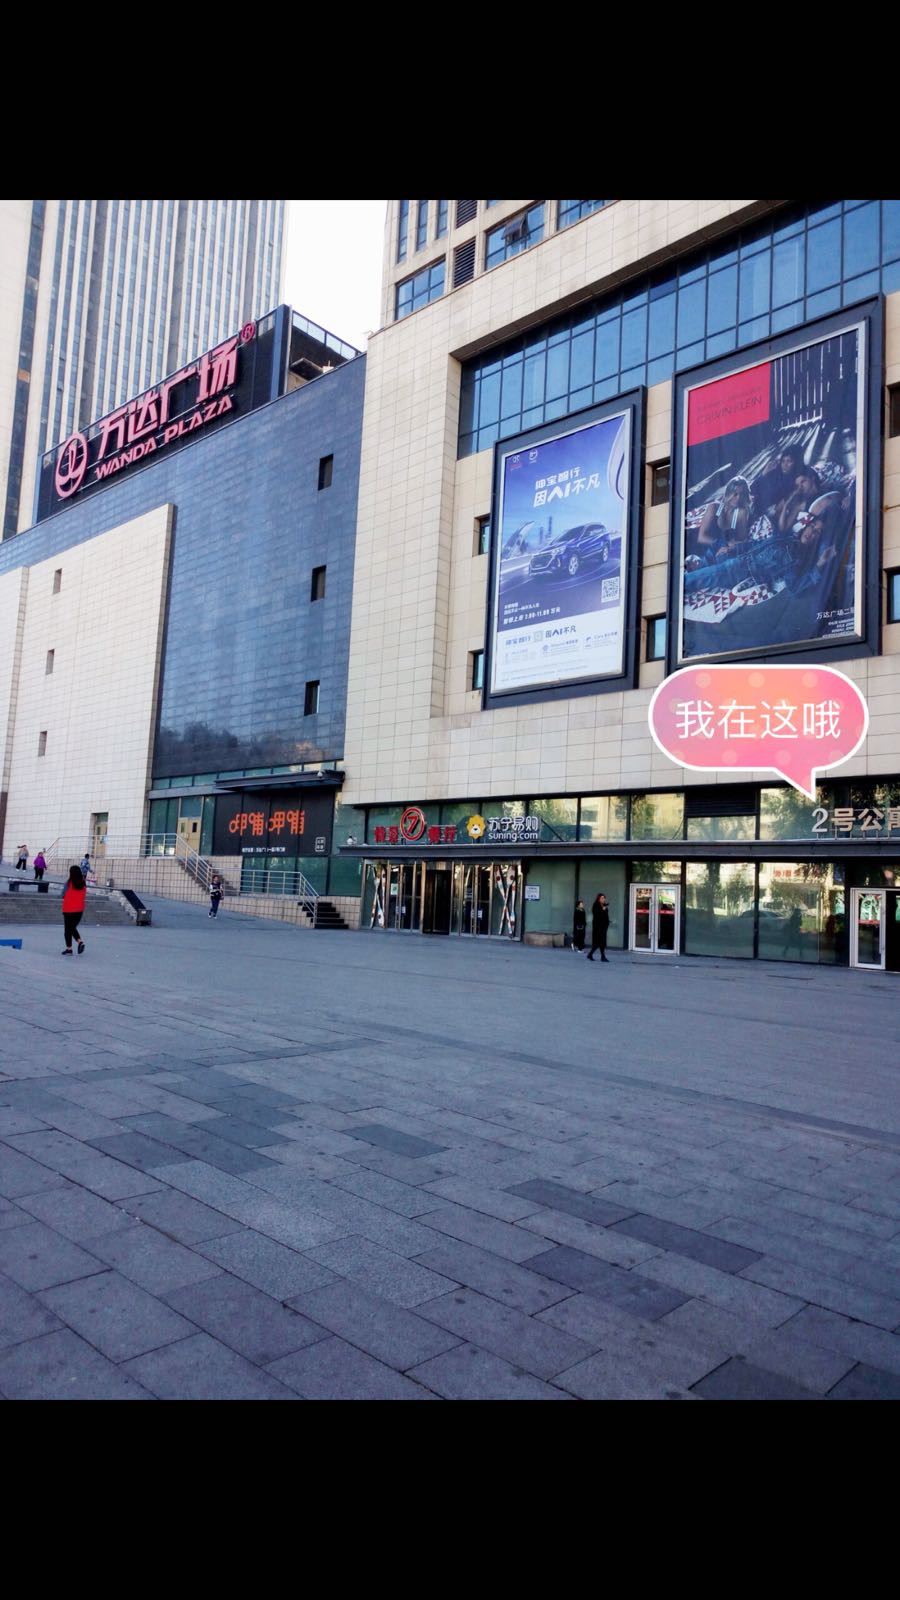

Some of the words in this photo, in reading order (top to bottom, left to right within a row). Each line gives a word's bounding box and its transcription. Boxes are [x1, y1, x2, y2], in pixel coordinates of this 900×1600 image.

[98, 338, 239, 459] 万达广场
[95, 437, 159, 479] WANDA
[165, 394, 234, 443] PLAZA
[533, 473, 600, 508] 因AI不凡
[488, 816, 539, 832] 苏宁易购
[488, 831, 538, 842] suning.com
